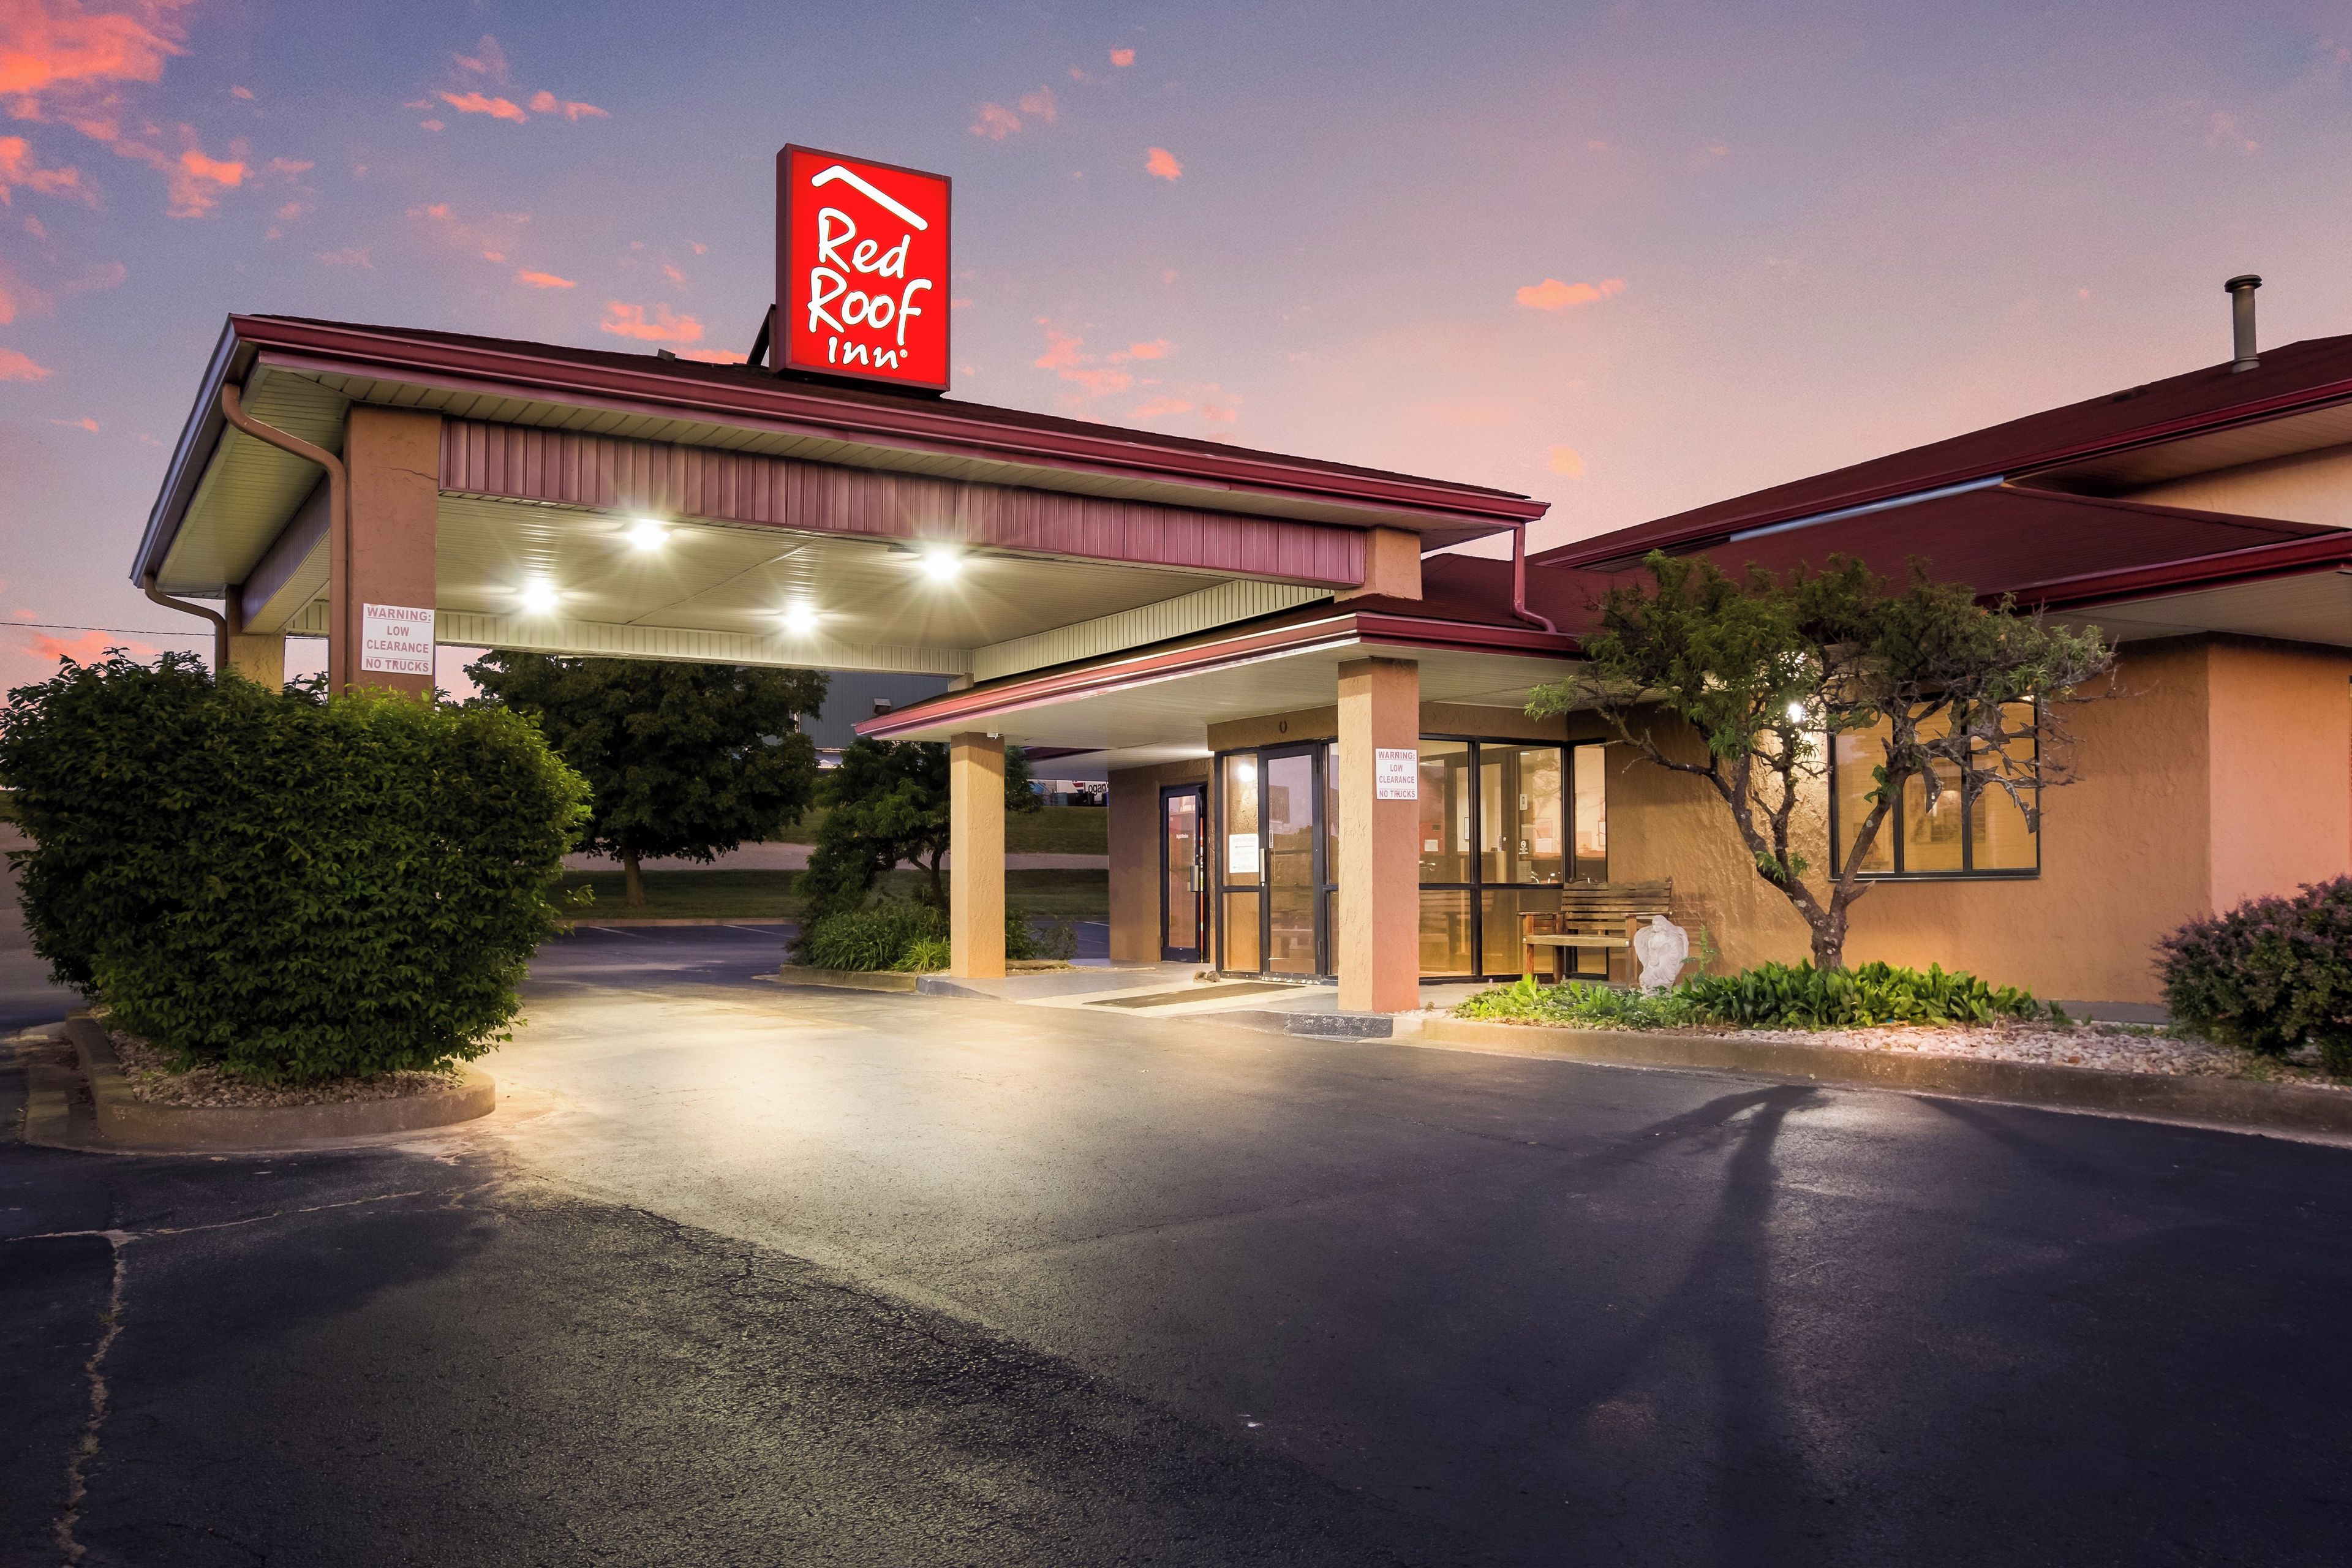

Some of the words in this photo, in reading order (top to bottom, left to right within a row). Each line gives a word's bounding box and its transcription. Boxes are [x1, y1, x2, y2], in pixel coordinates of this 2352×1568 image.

[818, 206, 911, 280] Red
[807, 266, 933, 347] Roof
[368, 606, 431, 622] WARNING:
[386, 625, 410, 637] LOW
[366, 639, 429, 654] CLEARANCE
[366, 658, 382, 669] NO
[385, 659, 429, 673] TRUCKS
[1378, 751, 1415, 760] WARNING:
[1390, 764, 1403, 772] LOW
